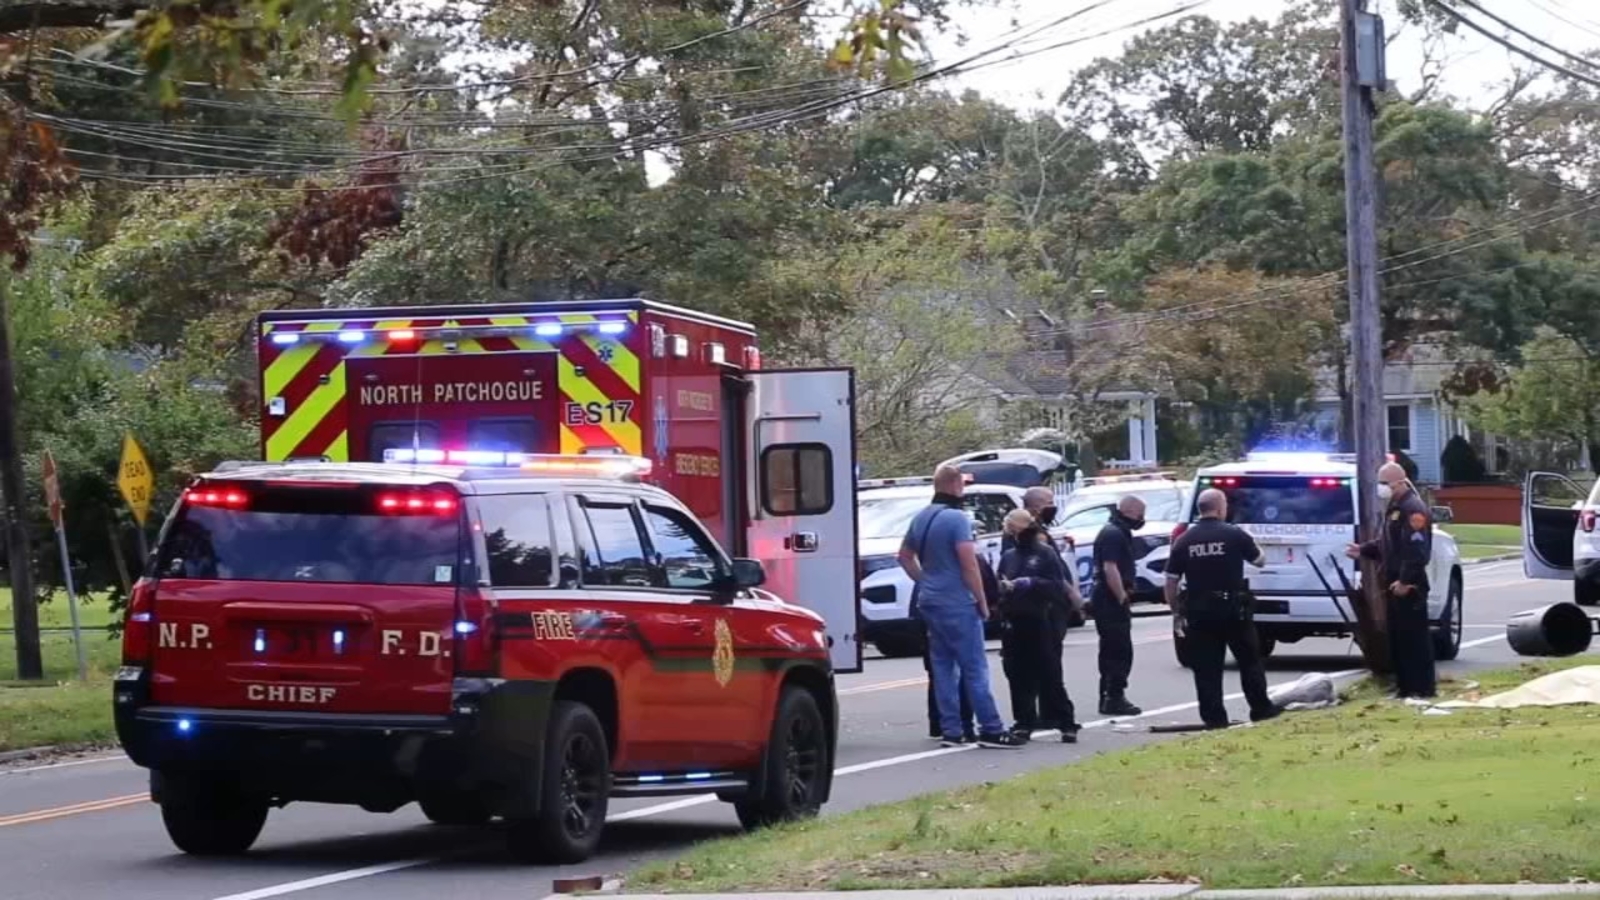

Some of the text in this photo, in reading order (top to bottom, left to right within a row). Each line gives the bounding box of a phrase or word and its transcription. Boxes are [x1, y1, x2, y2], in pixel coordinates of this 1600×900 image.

[360, 381, 542, 405] NORTH PATCHOGUE
[565, 400, 633, 426] ES17
[124, 460, 145, 478] DEAD
[131, 485, 146, 503] END
[1188, 542, 1226, 557] POLICE
[159, 622, 213, 649] N.P.
[531, 610, 576, 640] FIRE
[247, 684, 337, 704] CHIEF
